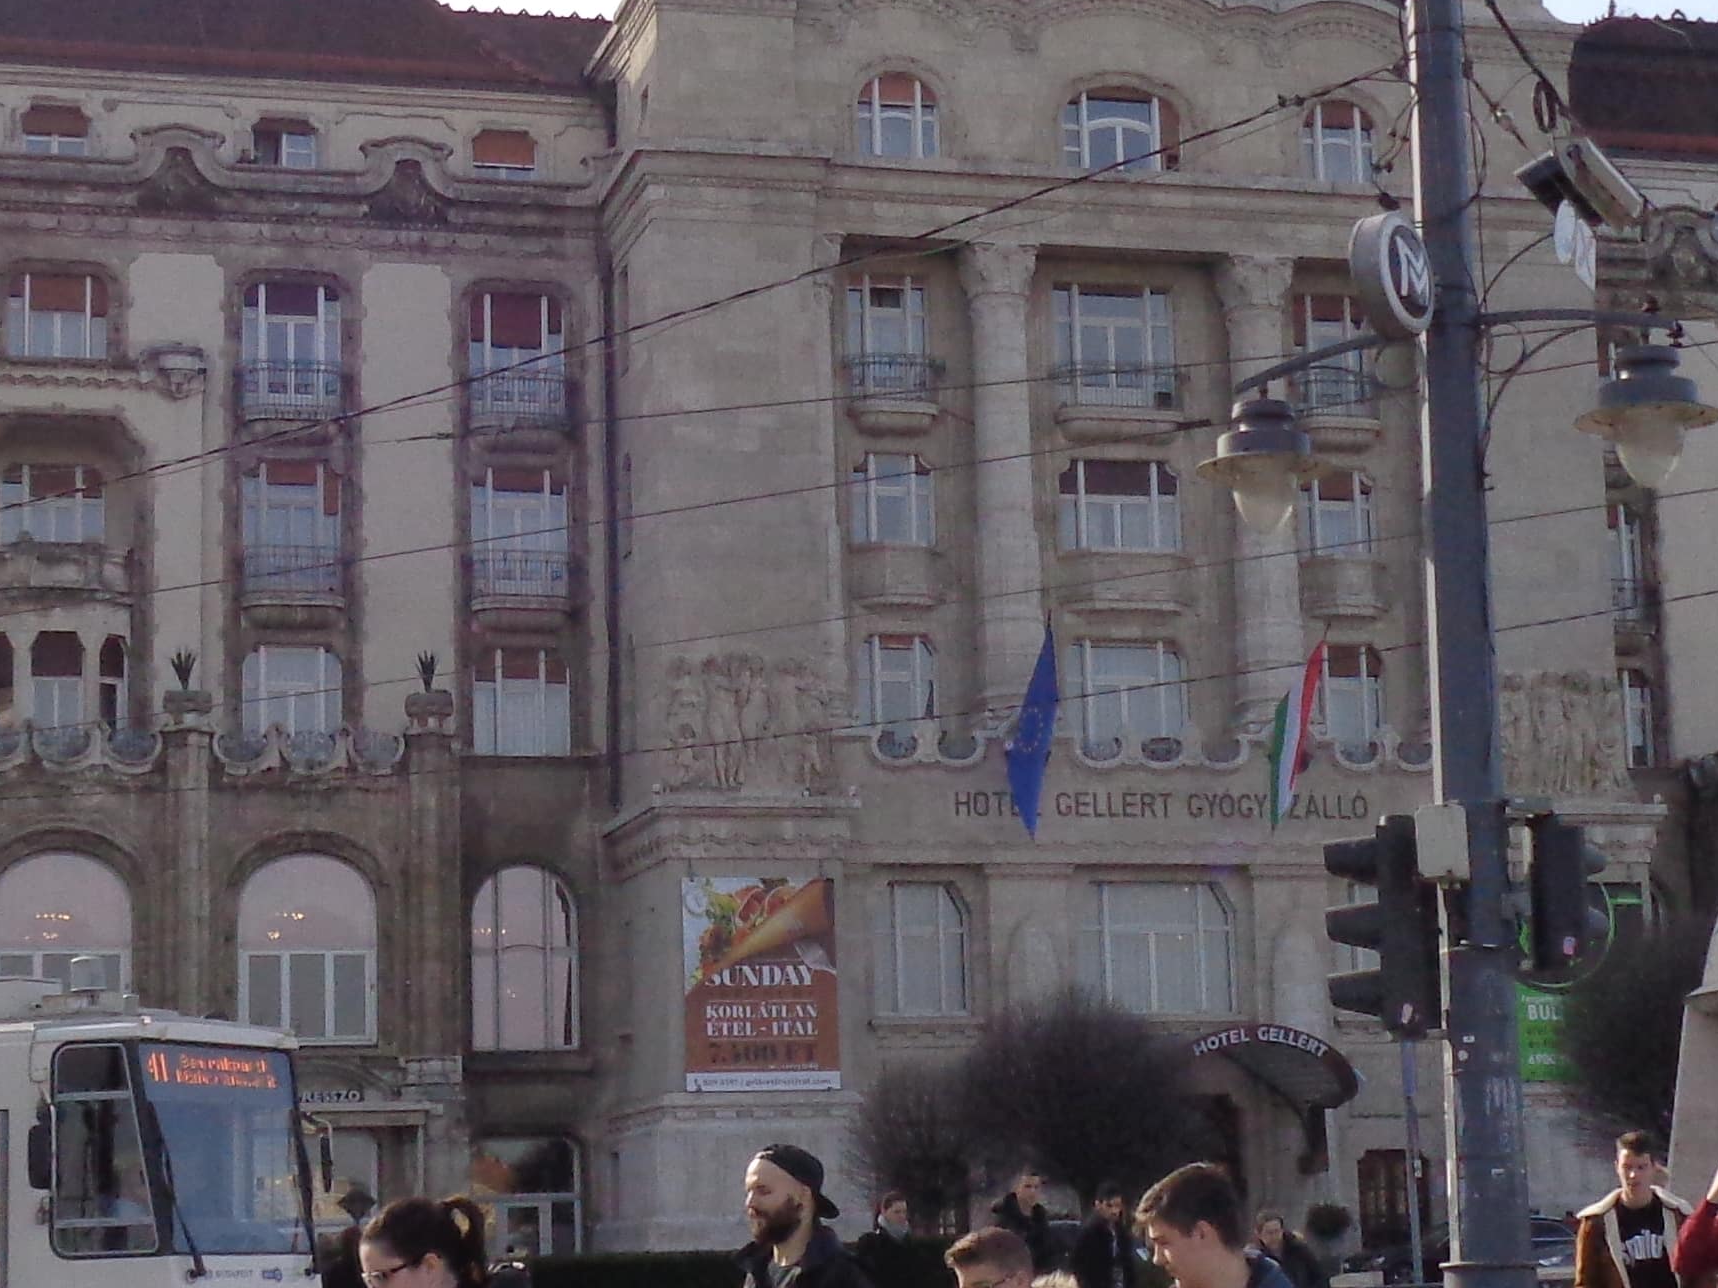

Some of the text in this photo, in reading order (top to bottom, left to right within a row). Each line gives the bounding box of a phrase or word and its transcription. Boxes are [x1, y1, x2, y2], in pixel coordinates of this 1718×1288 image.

[954, 789, 1369, 820] HOTE GELLÉRT GYÓGYZÁLLÓ
[705, 964, 813, 986] SUNDAY
[706, 1002, 818, 1019] KORLÁTLAN
[772, 1021, 818, 1036] ITAL
[1193, 1028, 1250, 1057] HOTEL
[301, 1090, 360, 1103] RESSZO
